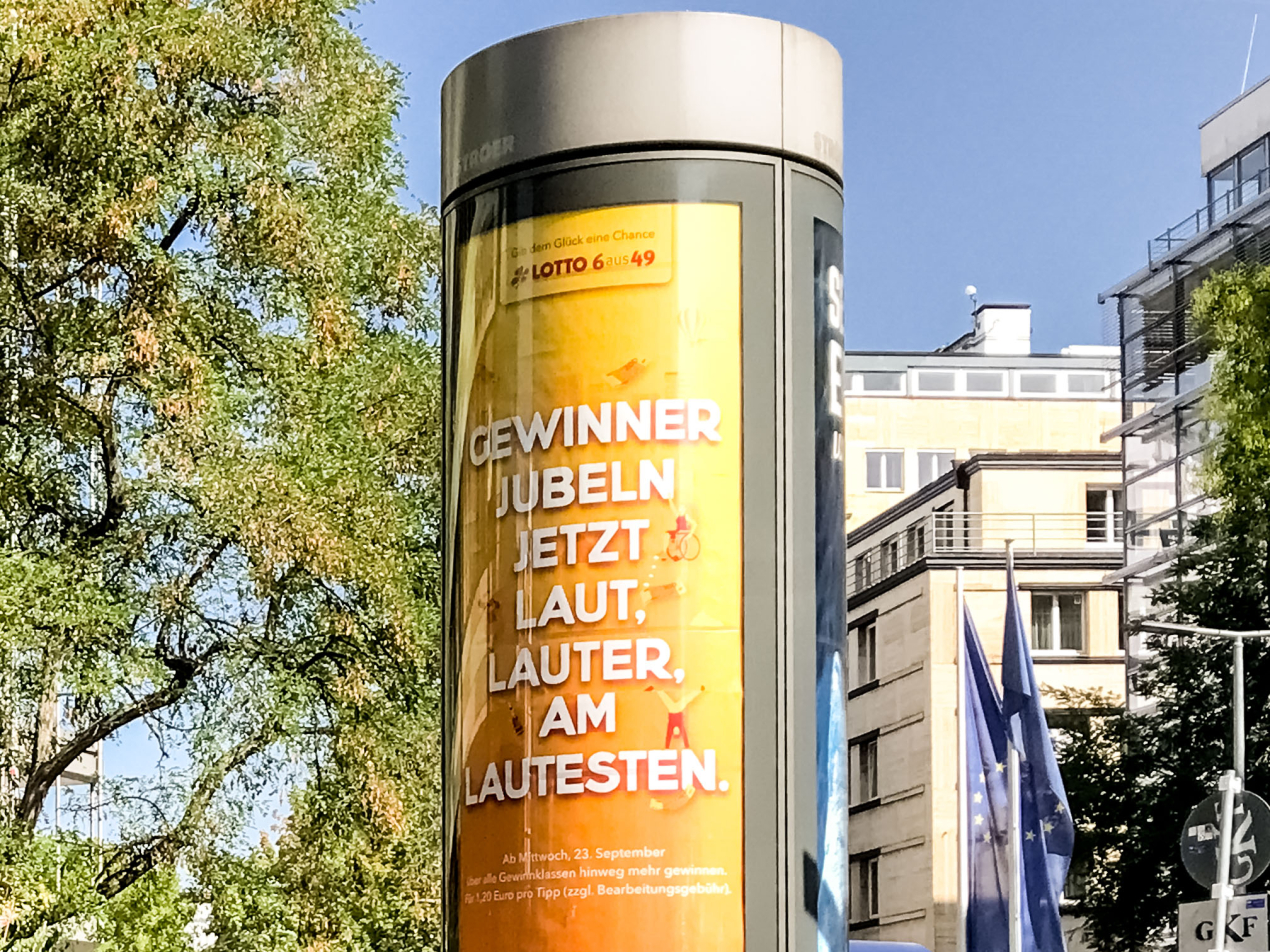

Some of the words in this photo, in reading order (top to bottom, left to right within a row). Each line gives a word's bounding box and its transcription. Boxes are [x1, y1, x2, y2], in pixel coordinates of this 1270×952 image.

[530, 242, 551, 254] dem
[554, 235, 583, 249] Glück
[586, 233, 610, 243] eine
[613, 229, 655, 242] Chance
[532, 256, 588, 280] LOTTO
[469, 398, 722, 467] GEWINNER
[496, 458, 675, 518] JUBELN
[514, 519, 650, 573] JETZT
[516, 579, 647, 630] LAUT,
[488, 638, 686, 692] LAUTER,
[538, 692, 616, 738] AM
[465, 749, 730, 806] LAUTESTEN.
[498, 868, 577, 883] Gewinnklassen
[579, 866, 625, 880] hinweg
[627, 864, 661, 876] mehr
[663, 864, 728, 879] gewinnen.
[502, 853, 517, 865] Ab
[518, 849, 571, 863] Mittwoch,
[573, 847, 593, 860] 23.
[595, 846, 666, 861] September
[493, 889, 515, 902] Euro
[516, 890, 534, 902] pro
[536, 886, 561, 900] Tipp
[563, 886, 595, 899] (zzgl.
[597, 881, 732, 898] Bearbeitungsgebühr).
